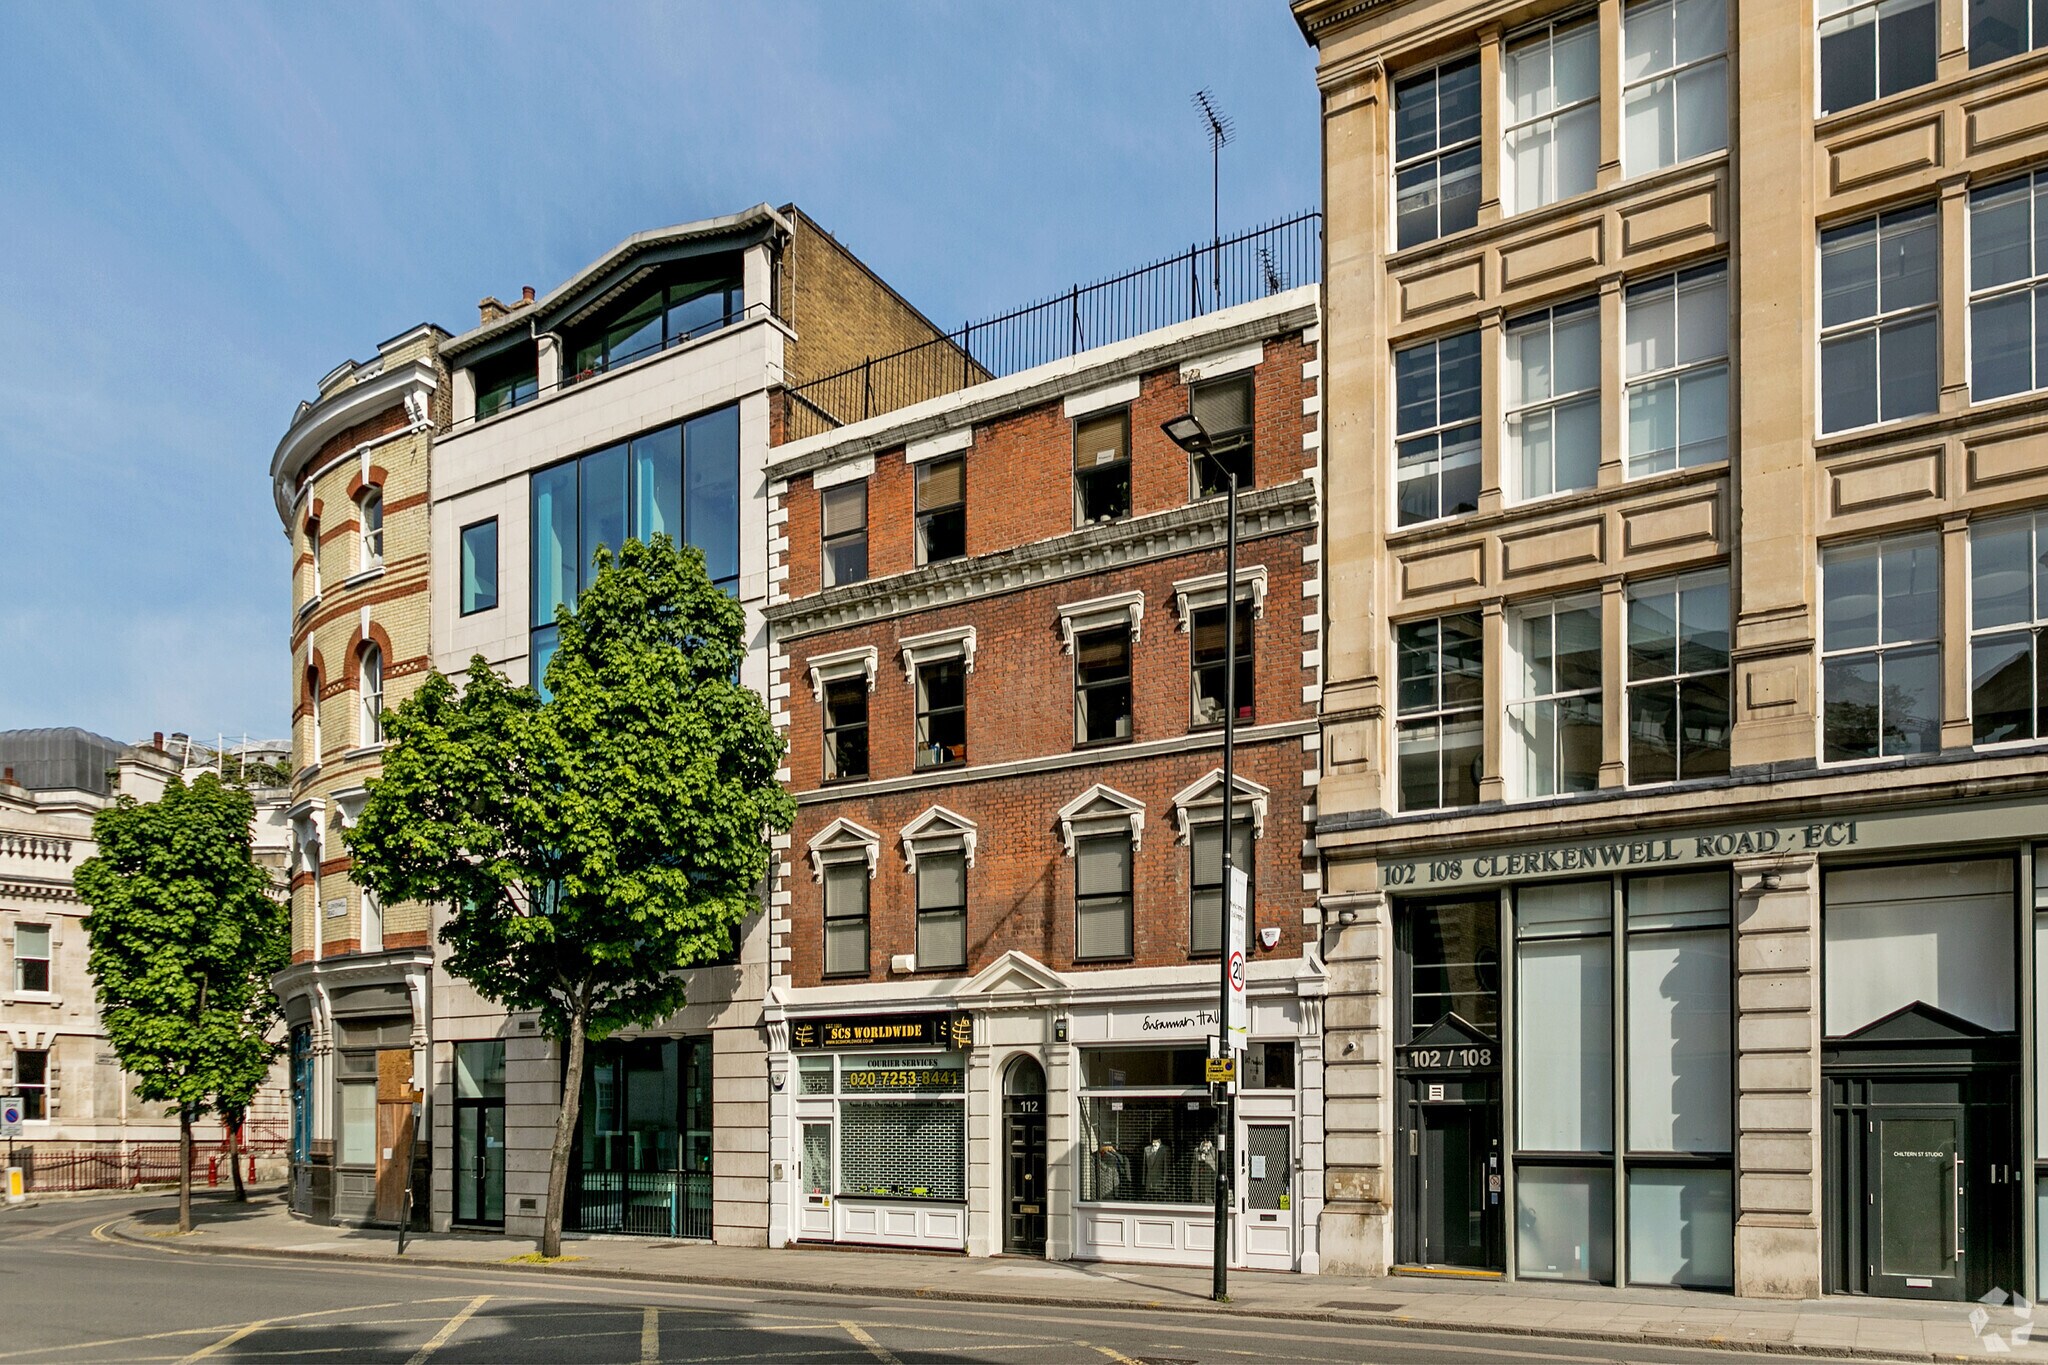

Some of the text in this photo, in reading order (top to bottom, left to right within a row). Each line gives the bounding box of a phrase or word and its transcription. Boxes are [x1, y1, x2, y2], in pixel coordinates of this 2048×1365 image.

[1384, 864, 1416, 886] 102
[1428, 858, 1463, 882] 108
[1473, 838, 1683, 878] CLERKENWELL
[1695, 827, 1781, 858] ROAD
[1801, 820, 1859, 849] EC1
[1233, 961, 1243, 982] 20
[1143, 1015, 1195, 1031] Susannah
[831, 1027, 851, 1039] SCS
[854, 1024, 922, 1038] WORLDWIDE
[867, 1058, 938, 1067] COURIER SERVICES
[1411, 1050, 1441, 1068] 102
[1459, 1048, 1492, 1066] 108
[850, 1071, 958, 1086] 020 7253 8441
[1020, 1101, 1038, 1112] 112
